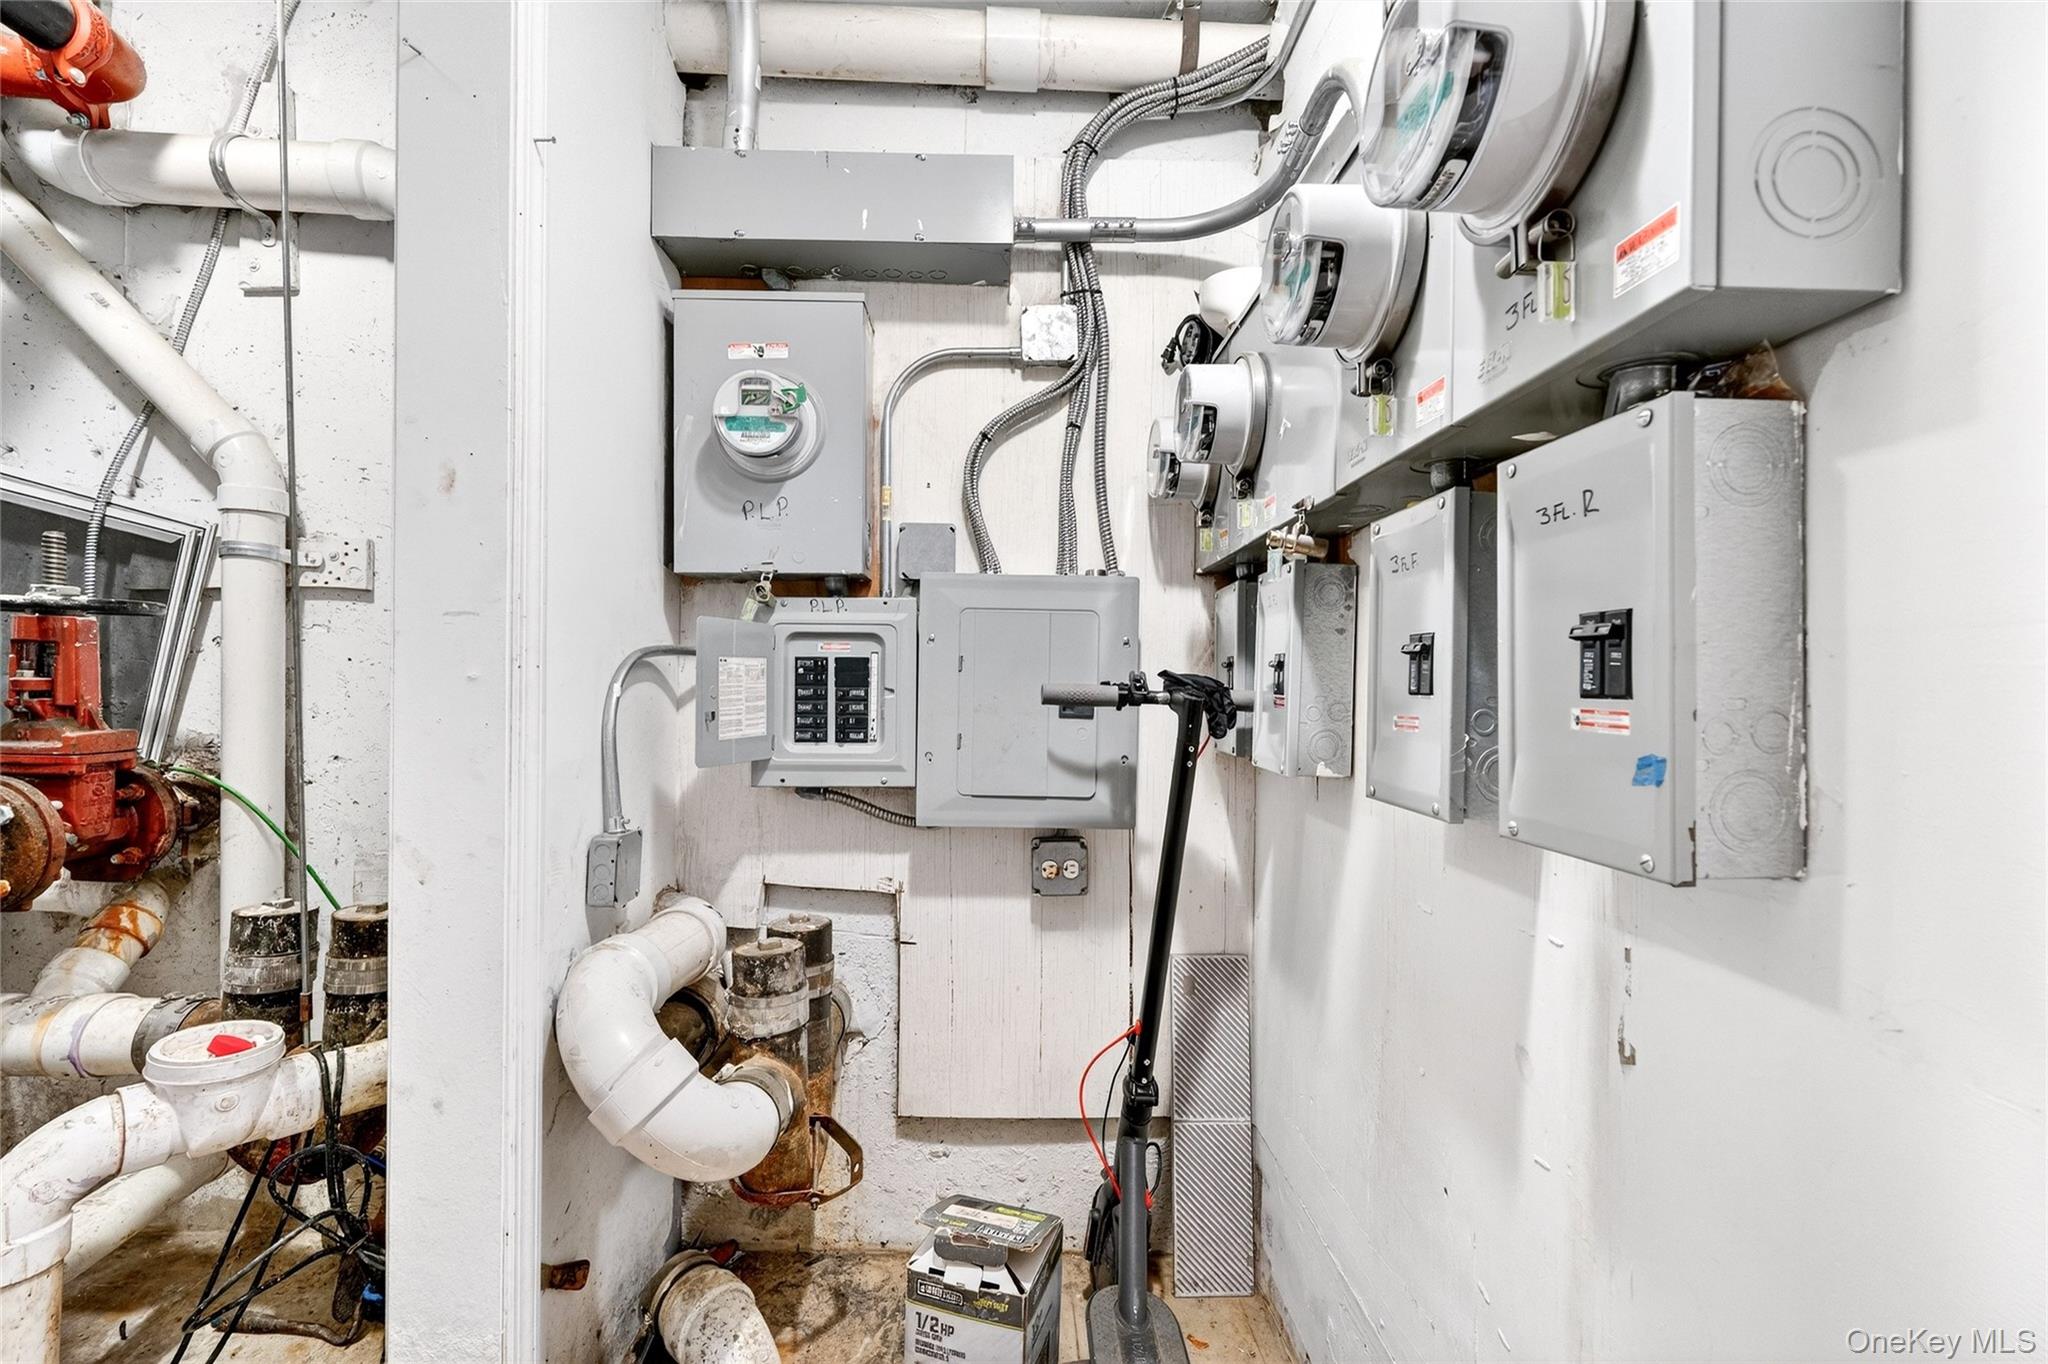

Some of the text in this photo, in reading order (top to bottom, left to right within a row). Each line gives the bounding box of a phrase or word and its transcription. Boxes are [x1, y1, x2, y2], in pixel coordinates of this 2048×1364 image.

[1582, 488, 1600, 518] R
[915, 1311, 939, 1334] 1/2
[940, 1322, 955, 1337] HP
